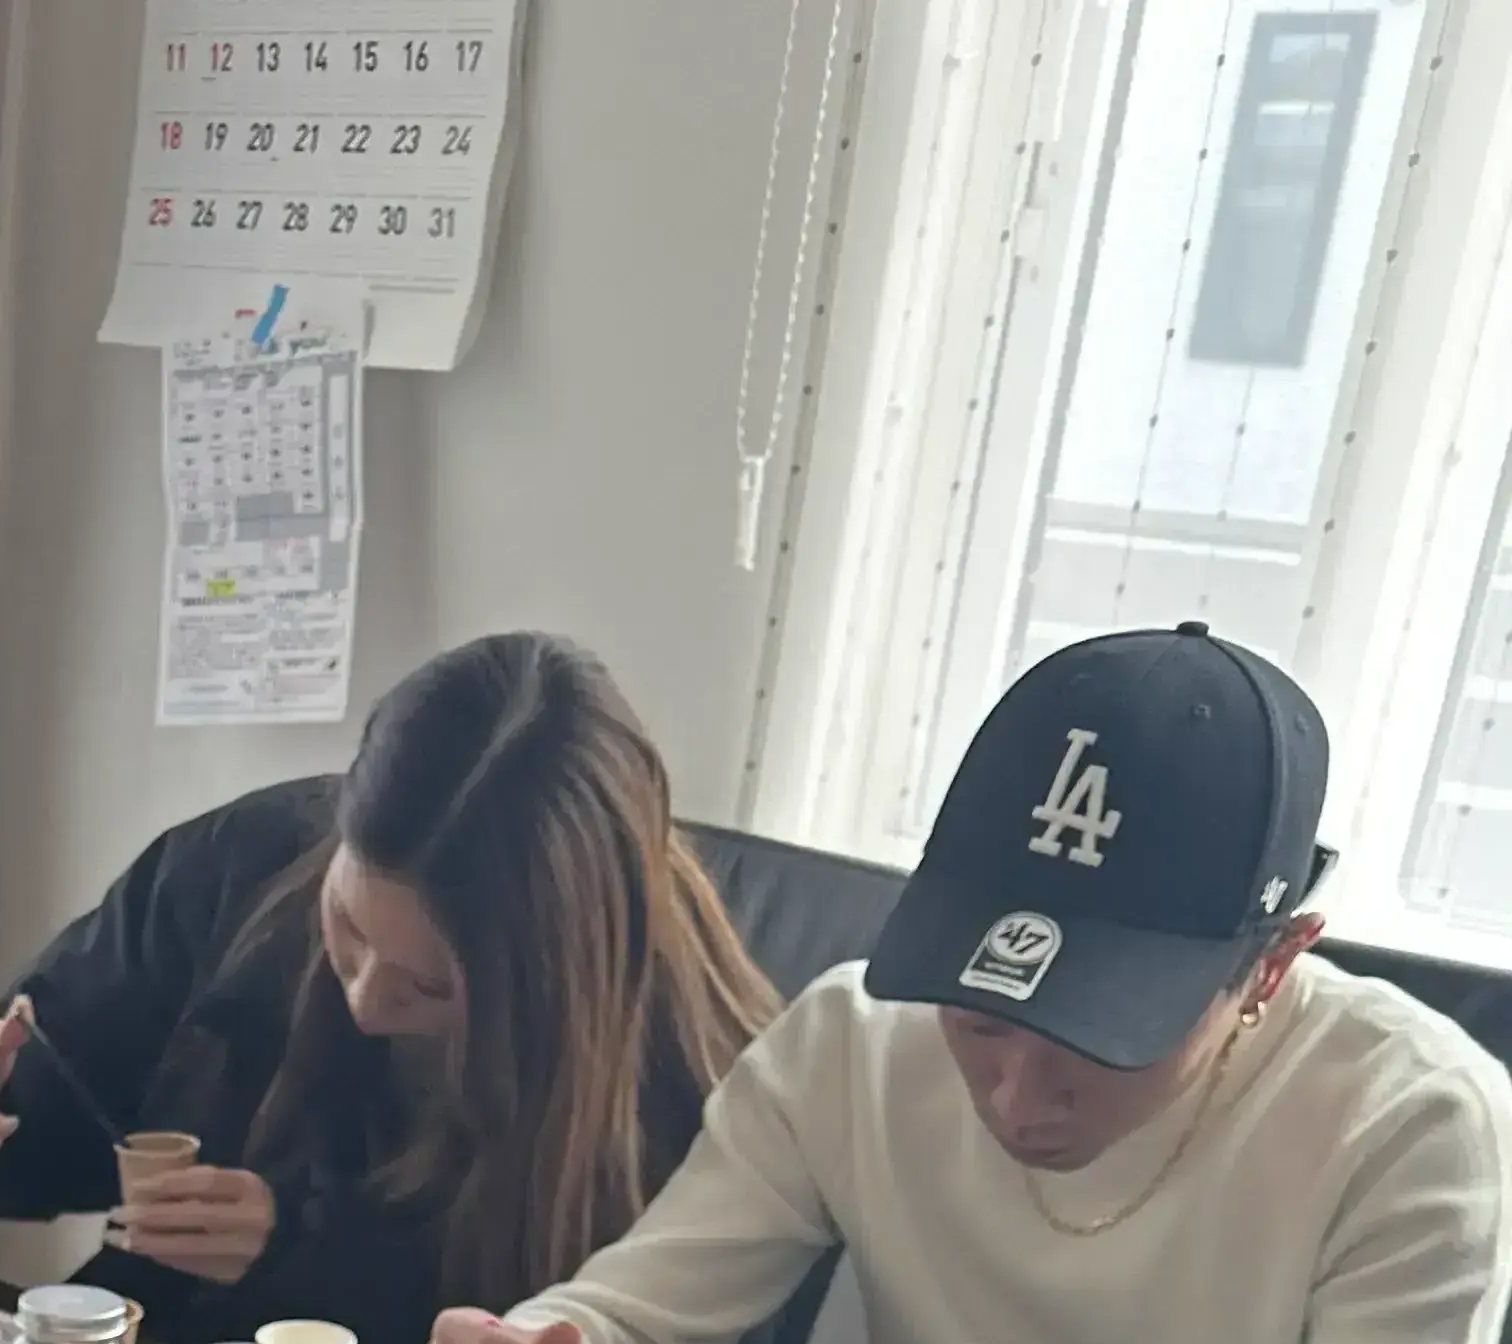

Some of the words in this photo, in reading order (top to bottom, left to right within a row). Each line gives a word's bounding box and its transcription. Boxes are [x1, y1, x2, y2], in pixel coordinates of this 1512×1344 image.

[166, 43, 186, 71] 11
[211, 43, 234, 71] 12
[256, 42, 281, 71] 13
[304, 41, 328, 71] 14
[353, 40, 379, 72] 15
[403, 40, 429, 72] 16
[456, 40, 483, 72] 17
[161, 121, 183, 151] 18
[205, 121, 229, 151] 19
[247, 122, 275, 152] 20
[293, 123, 320, 154] 21
[341, 123, 372, 153] 22
[390, 124, 422, 154] 23
[441, 124, 475, 155] 24
[148, 198, 174, 228] 25
[191, 199, 217, 228] 26
[236, 200, 263, 231] 27
[282, 201, 309, 231] 28
[329, 204, 358, 234] 29
[378, 204, 408, 235] 30
[427, 207, 456, 238] 31
[1028, 728, 1123, 868] LA
